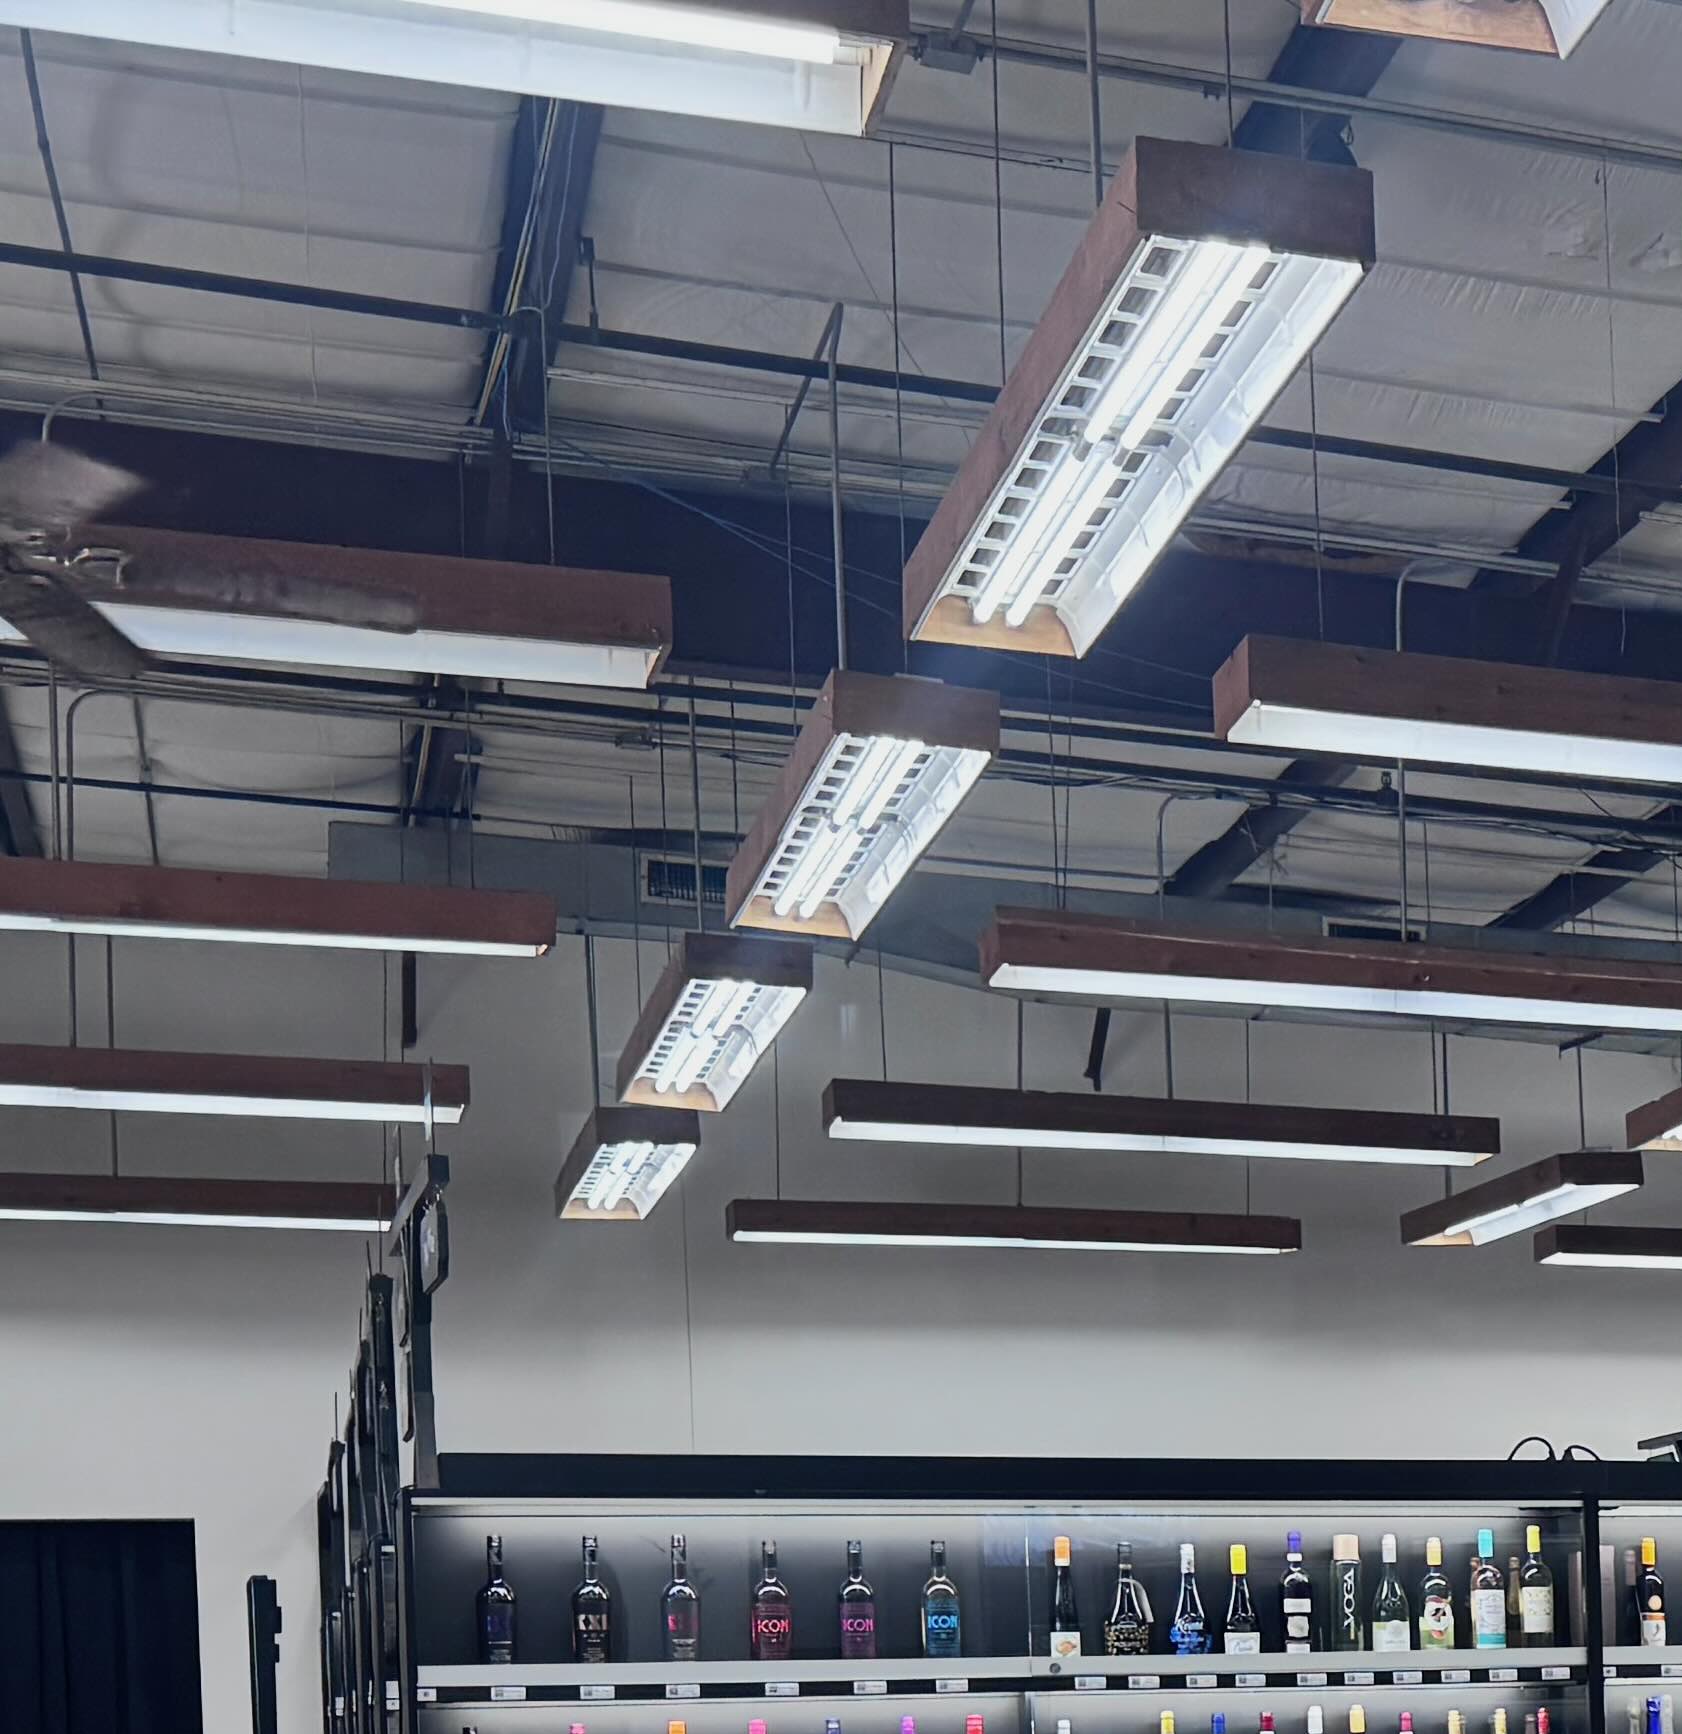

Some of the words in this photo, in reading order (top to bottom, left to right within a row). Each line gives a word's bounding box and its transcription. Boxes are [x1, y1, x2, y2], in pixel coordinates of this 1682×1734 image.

[1343, 1567, 1355, 1628] VOGA
[757, 1618, 790, 1633] ICON
[842, 1618, 875, 1632] ICON
[927, 1614, 958, 1629] ICON
